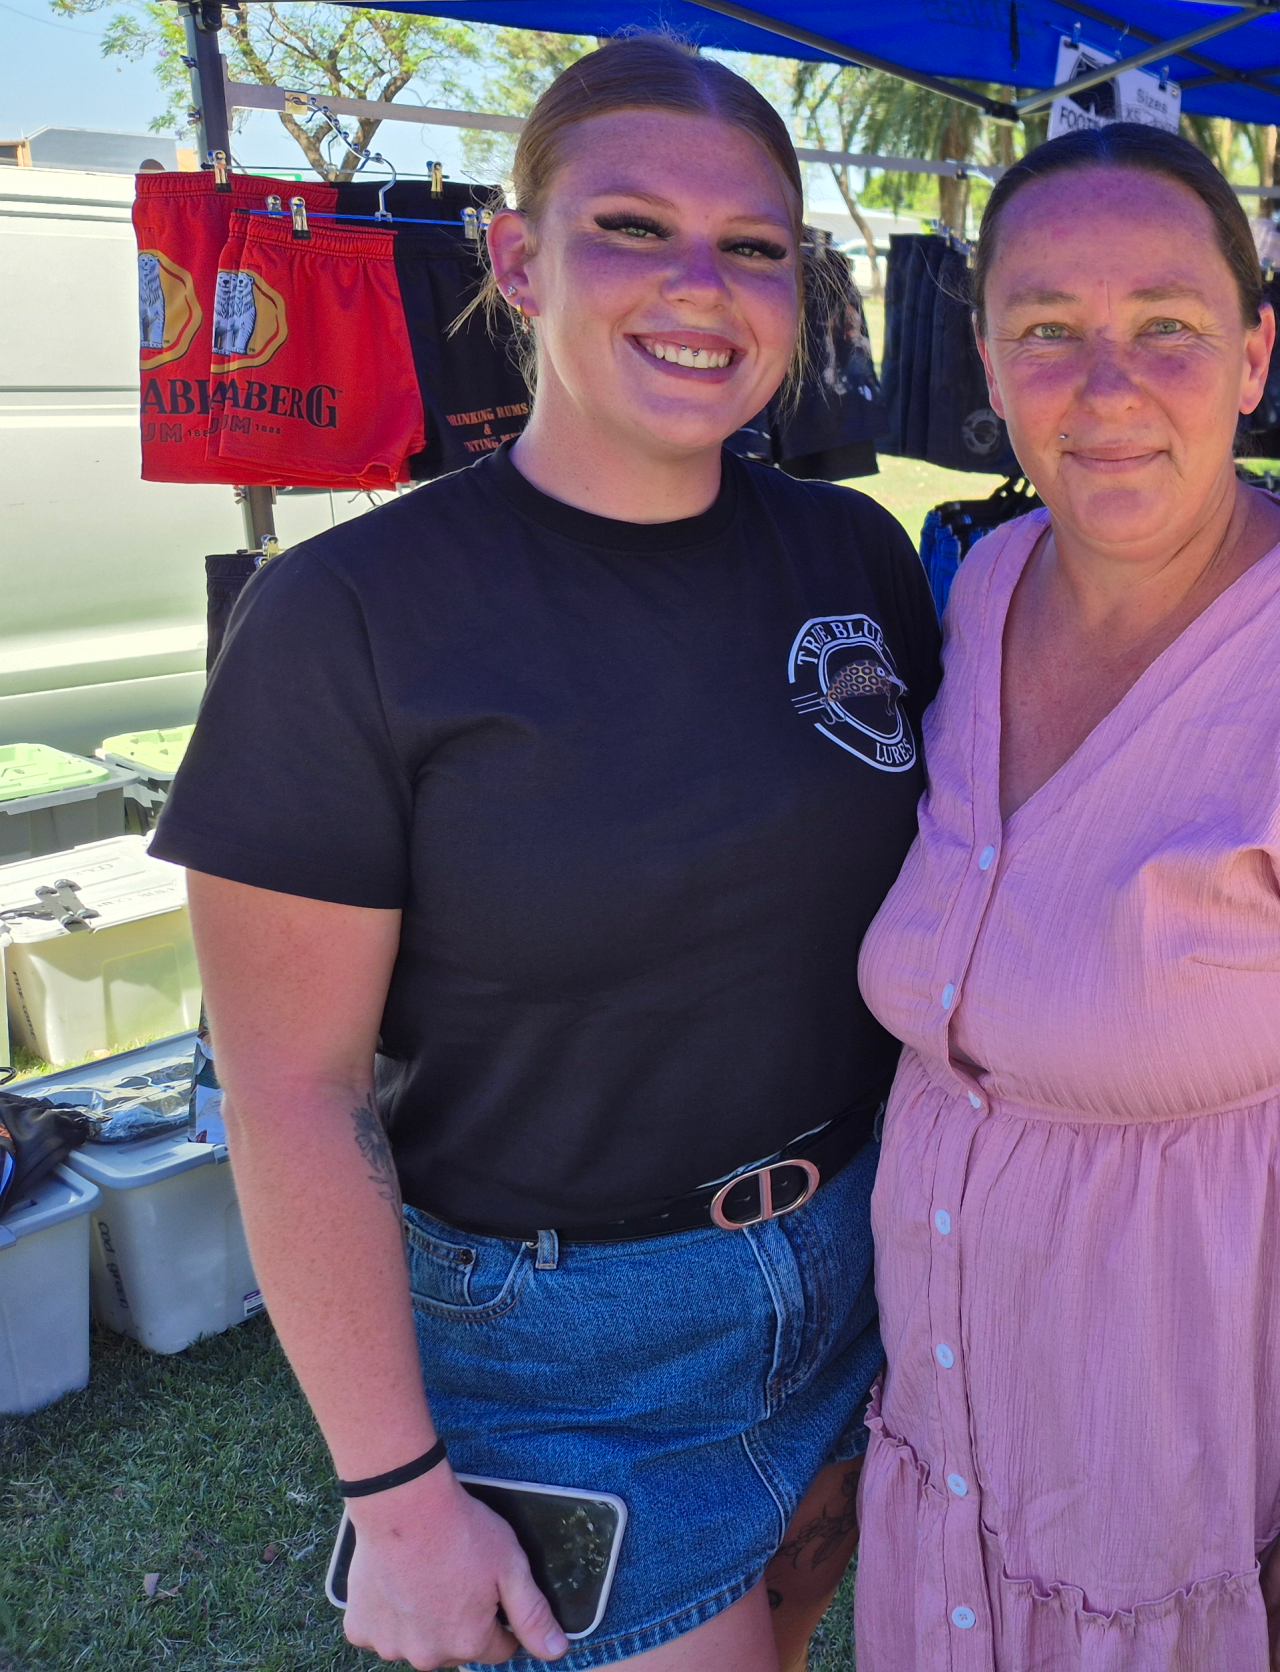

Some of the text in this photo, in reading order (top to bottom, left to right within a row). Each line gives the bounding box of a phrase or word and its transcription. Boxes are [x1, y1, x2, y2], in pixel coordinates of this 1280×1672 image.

[496, 402, 530, 418] RUMS
[483, 423, 492, 435] &
[797, 620, 885, 666] TRUE BLUE
[875, 738, 913, 765] LURES
